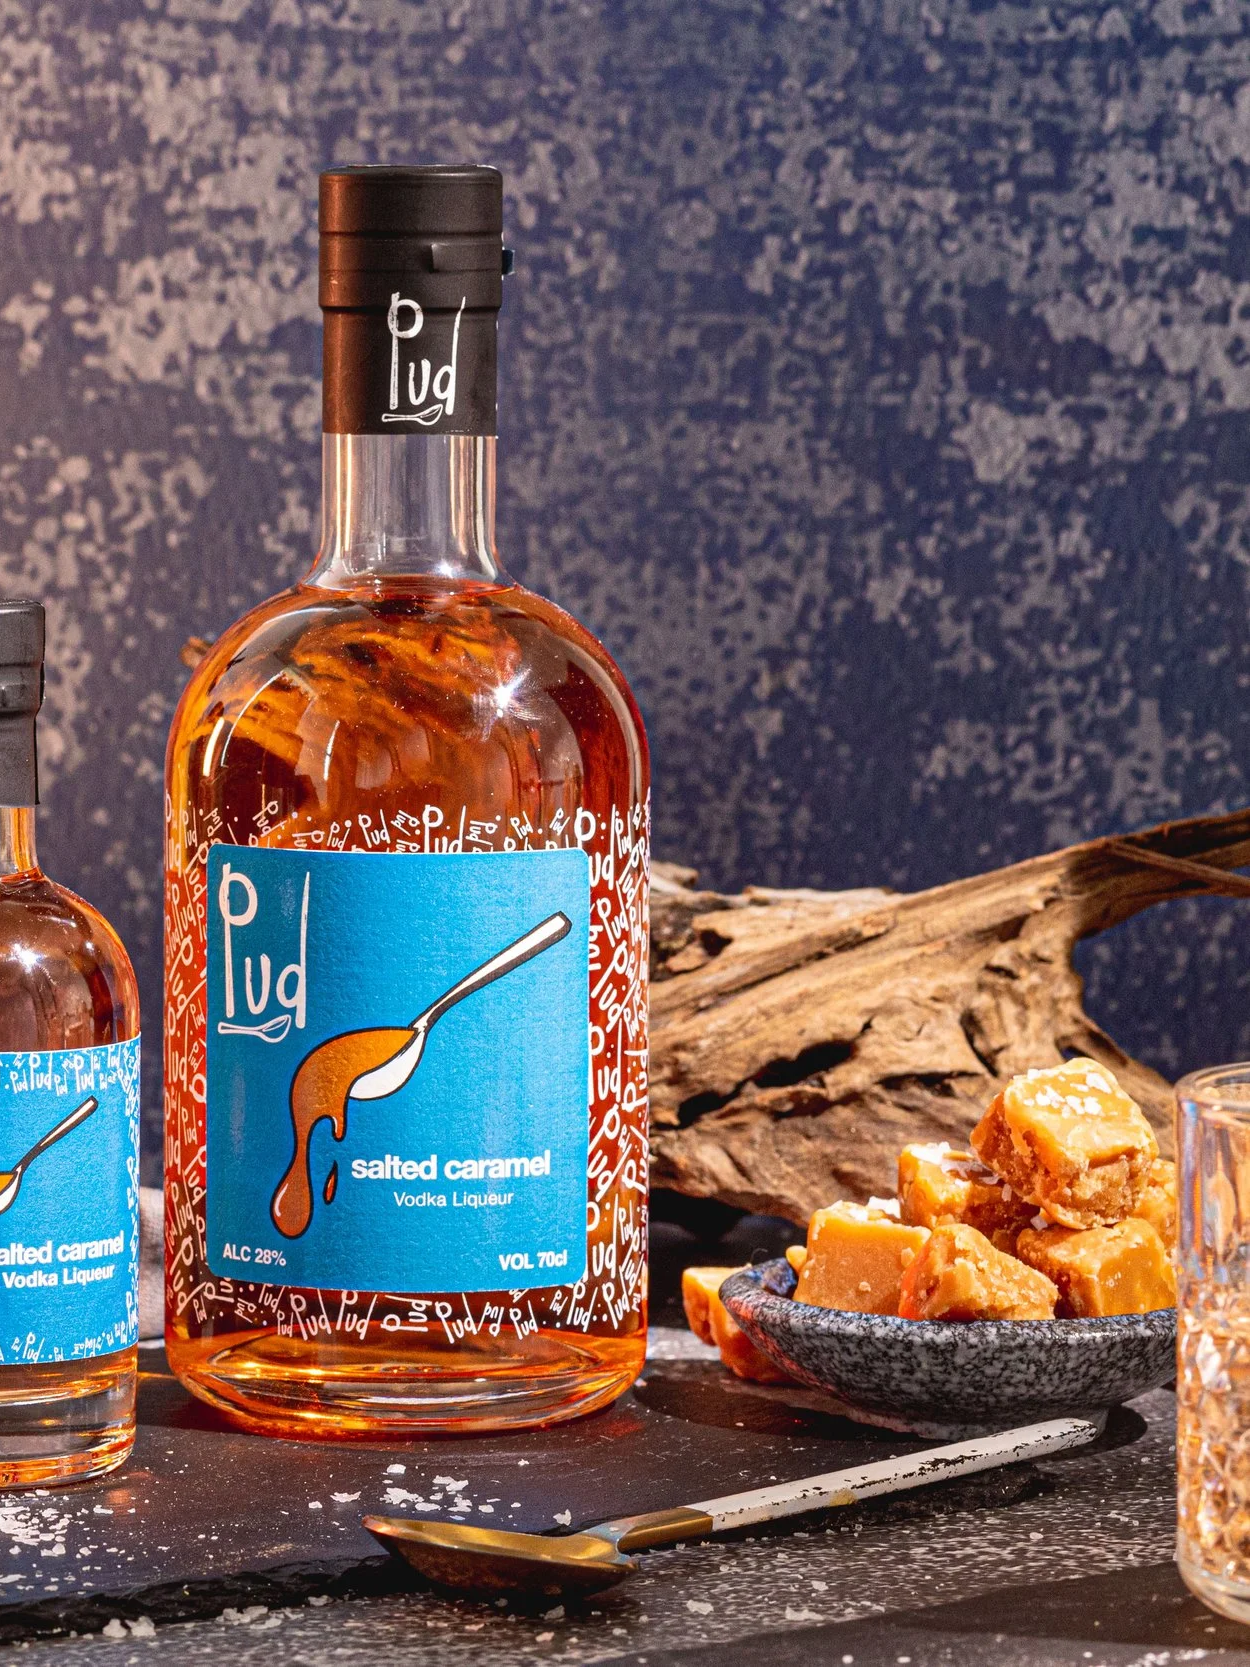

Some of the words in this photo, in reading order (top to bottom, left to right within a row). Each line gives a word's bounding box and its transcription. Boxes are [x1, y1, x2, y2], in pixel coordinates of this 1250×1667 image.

[387, 291, 466, 416] Pud
[358, 809, 391, 849] Pud
[391, 809, 419, 837] Pud
[422, 804, 466, 854] Pud
[465, 819, 498, 846] Pud
[510, 810, 534, 840] Pud
[217, 862, 310, 1029] Pud
[10, 1069, 29, 1094] Pud
[29, 1052, 53, 1091] Pud
[351, 1154, 437, 1180] salted
[444, 1150, 551, 1180] caramel
[393, 1192, 447, 1207] Vodka
[452, 1192, 514, 1209] Liqueur
[57, 1230, 124, 1262] caramel
[222, 1243, 251, 1262] ALC
[254, 1248, 287, 1267] 28%
[499, 1254, 534, 1271] VOL
[537, 1249, 568, 1268] 70cl
[2, 1270, 58, 1289] Vodka
[63, 1264, 115, 1286] Liqueur
[276, 1309, 294, 1338] Pud
[290, 1288, 331, 1341] Pud
[336, 1289, 377, 1341] Pud
[434, 1292, 477, 1344] Pud
[509, 1299, 538, 1341] Pud
